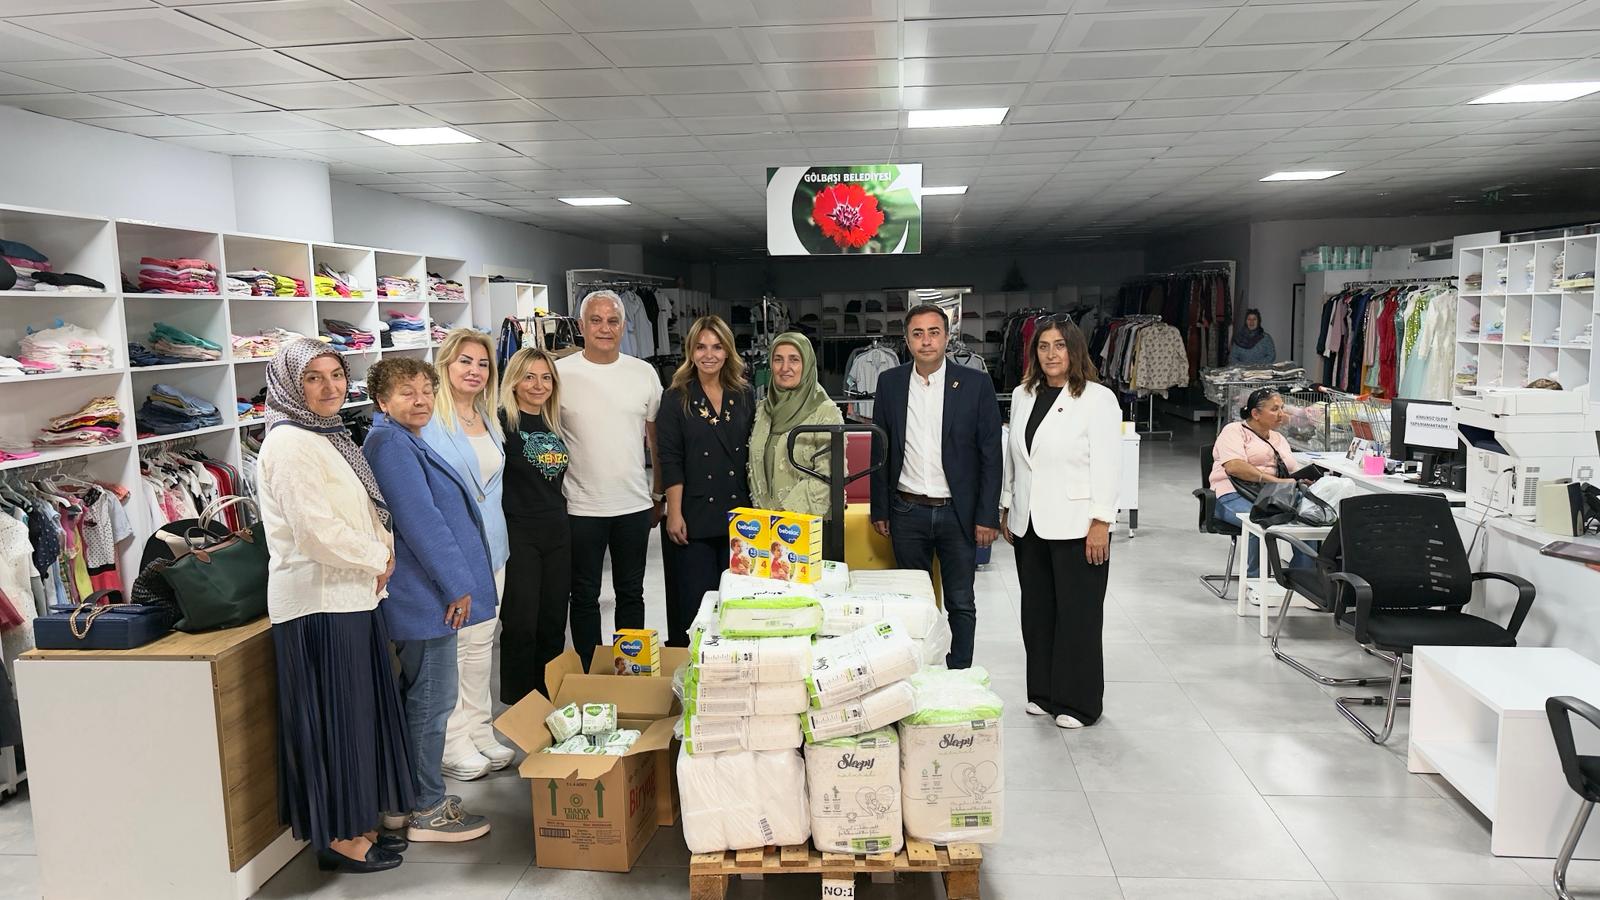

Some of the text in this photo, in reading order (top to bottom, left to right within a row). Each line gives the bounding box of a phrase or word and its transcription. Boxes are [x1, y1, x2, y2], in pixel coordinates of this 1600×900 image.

[804, 171, 891, 184] GÖLBAŞI BELEDİYESİ
[538, 453, 569, 463] KENZO
[737, 523, 759, 531] bebelac
[778, 527, 799, 536] bebelac
[761, 560, 767, 568] 4
[800, 566, 807, 574] 4
[939, 733, 975, 749] Sleepy
[837, 753, 875, 771] Sleepy
[563, 807, 591, 815] TRAKYA
[824, 886, 854, 897] NO:1
